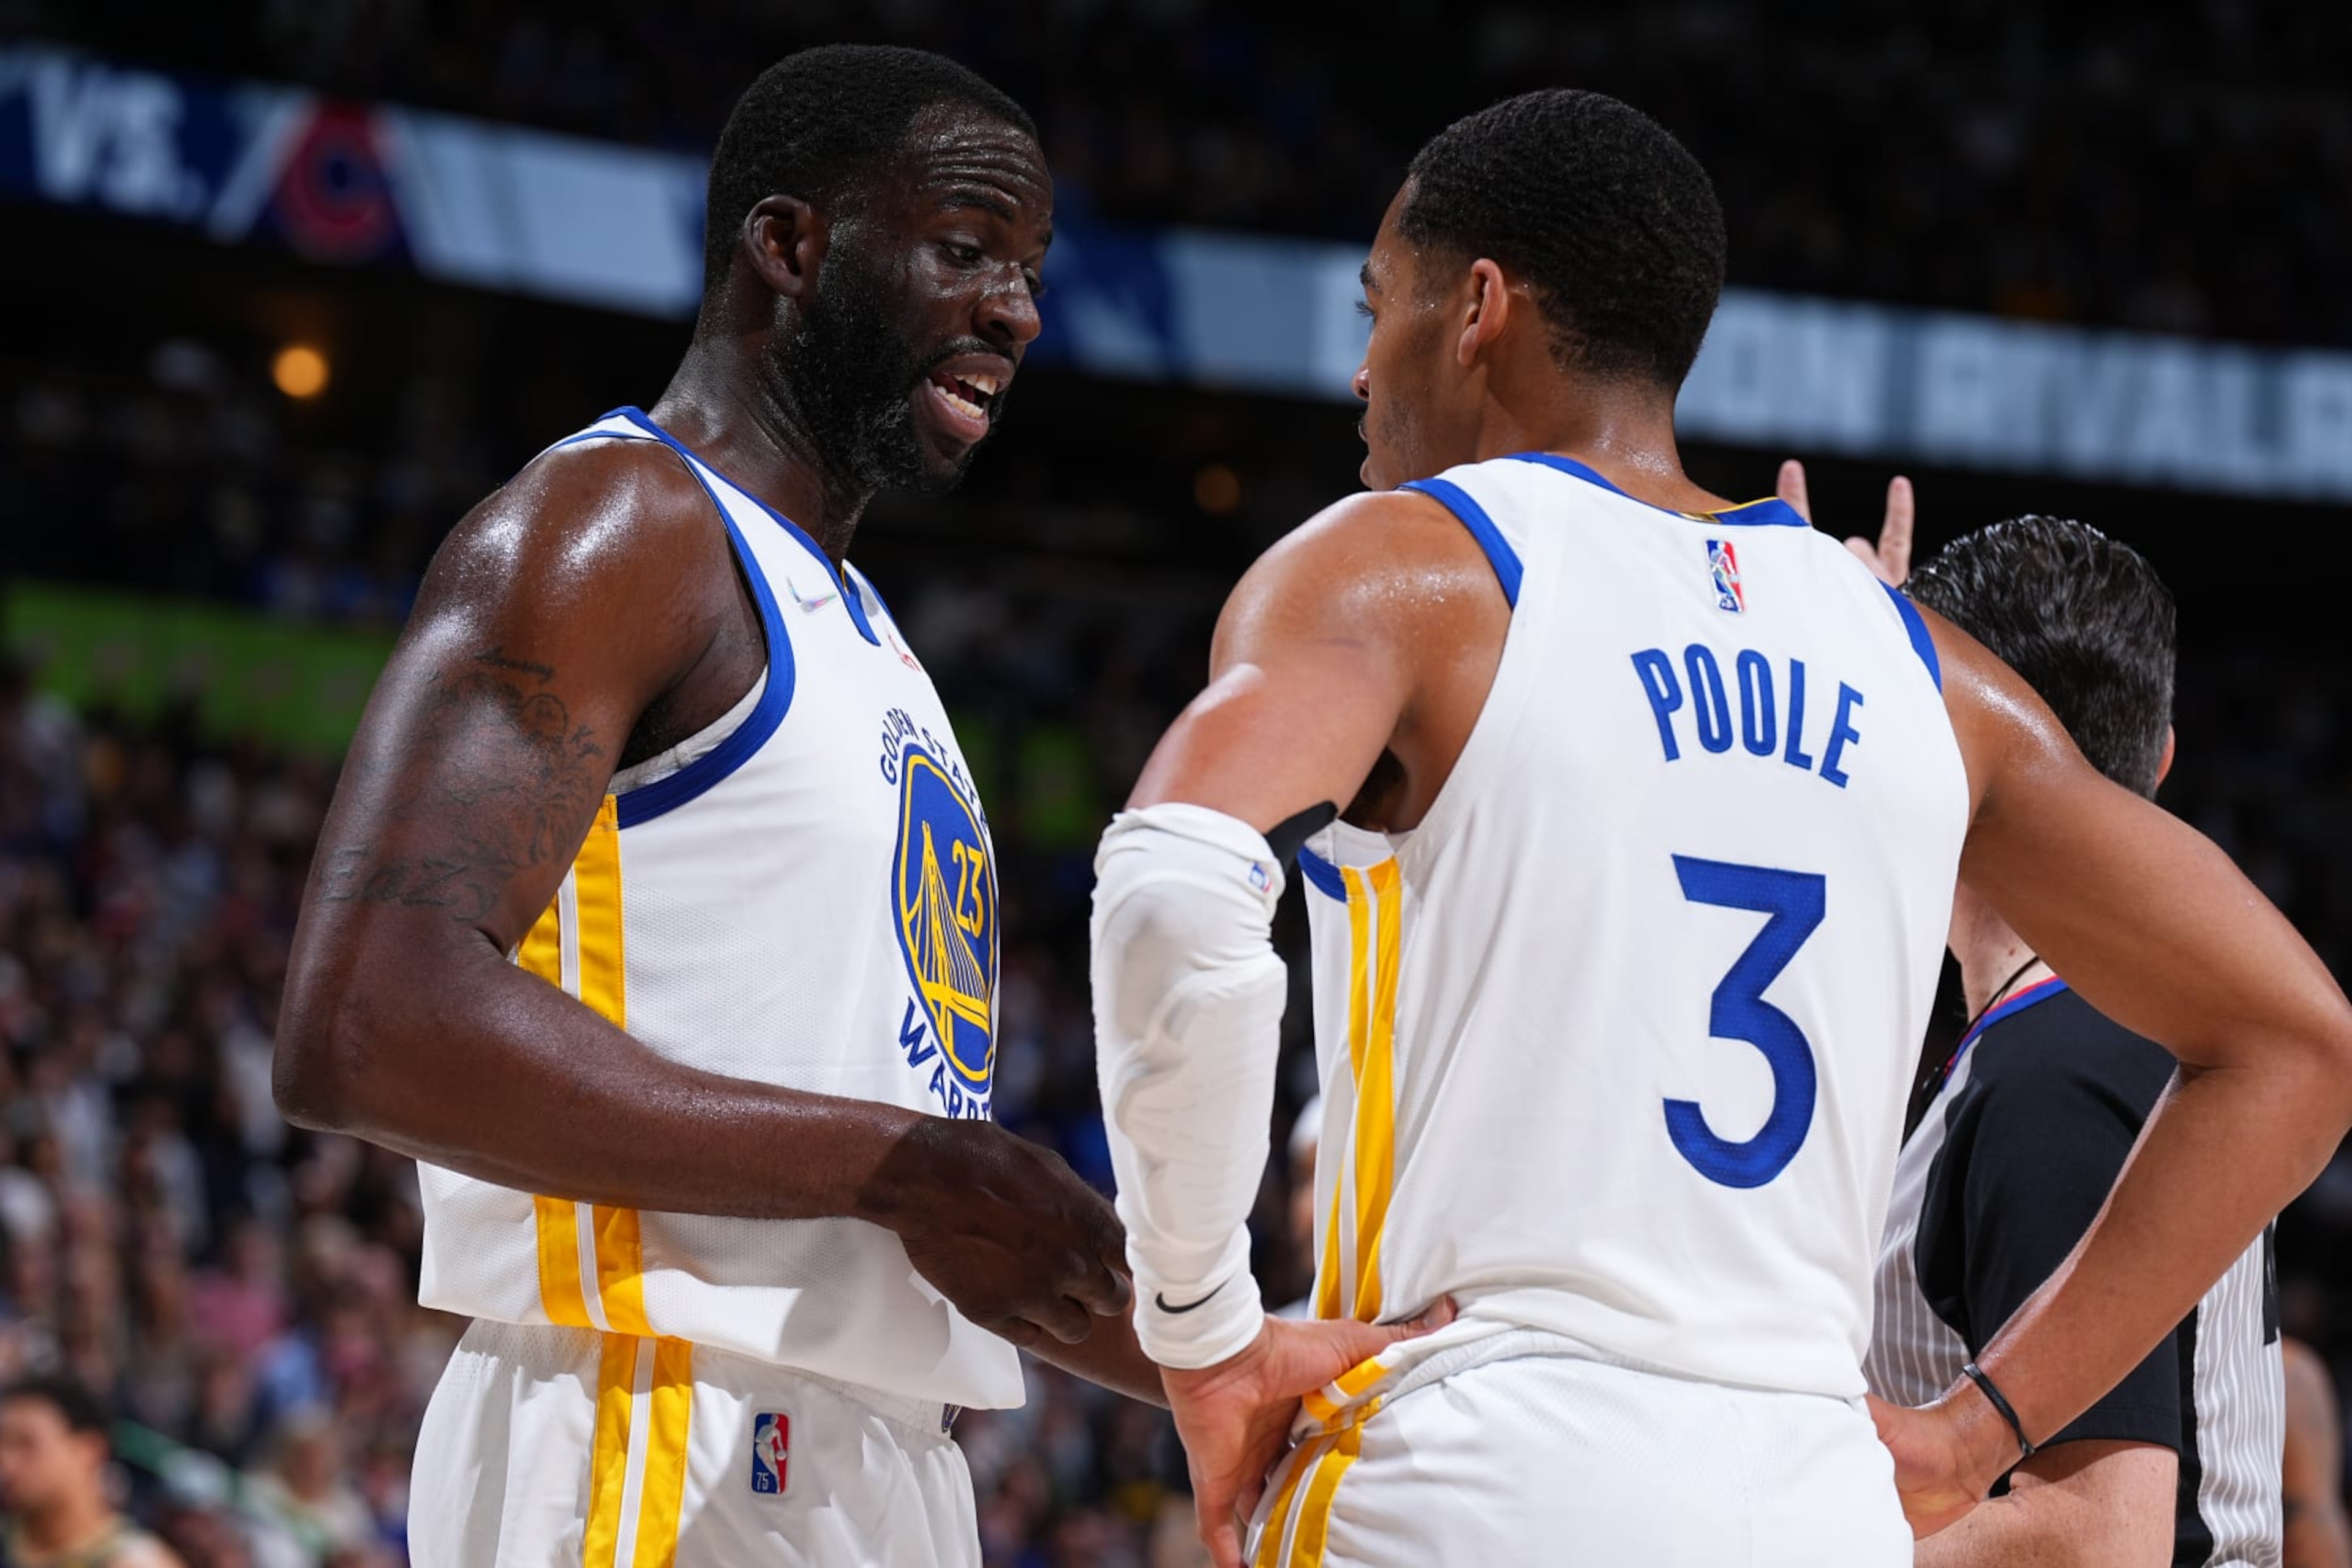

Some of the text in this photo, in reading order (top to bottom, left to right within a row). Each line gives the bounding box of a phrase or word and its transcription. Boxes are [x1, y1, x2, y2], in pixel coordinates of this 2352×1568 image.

[880, 707, 919, 786] GOLDEN
[1630, 643, 1864, 788] POOLE
[952, 839, 984, 939] 23
[1662, 853, 1826, 1189] 3
[756, 1472, 769, 1491] 75
